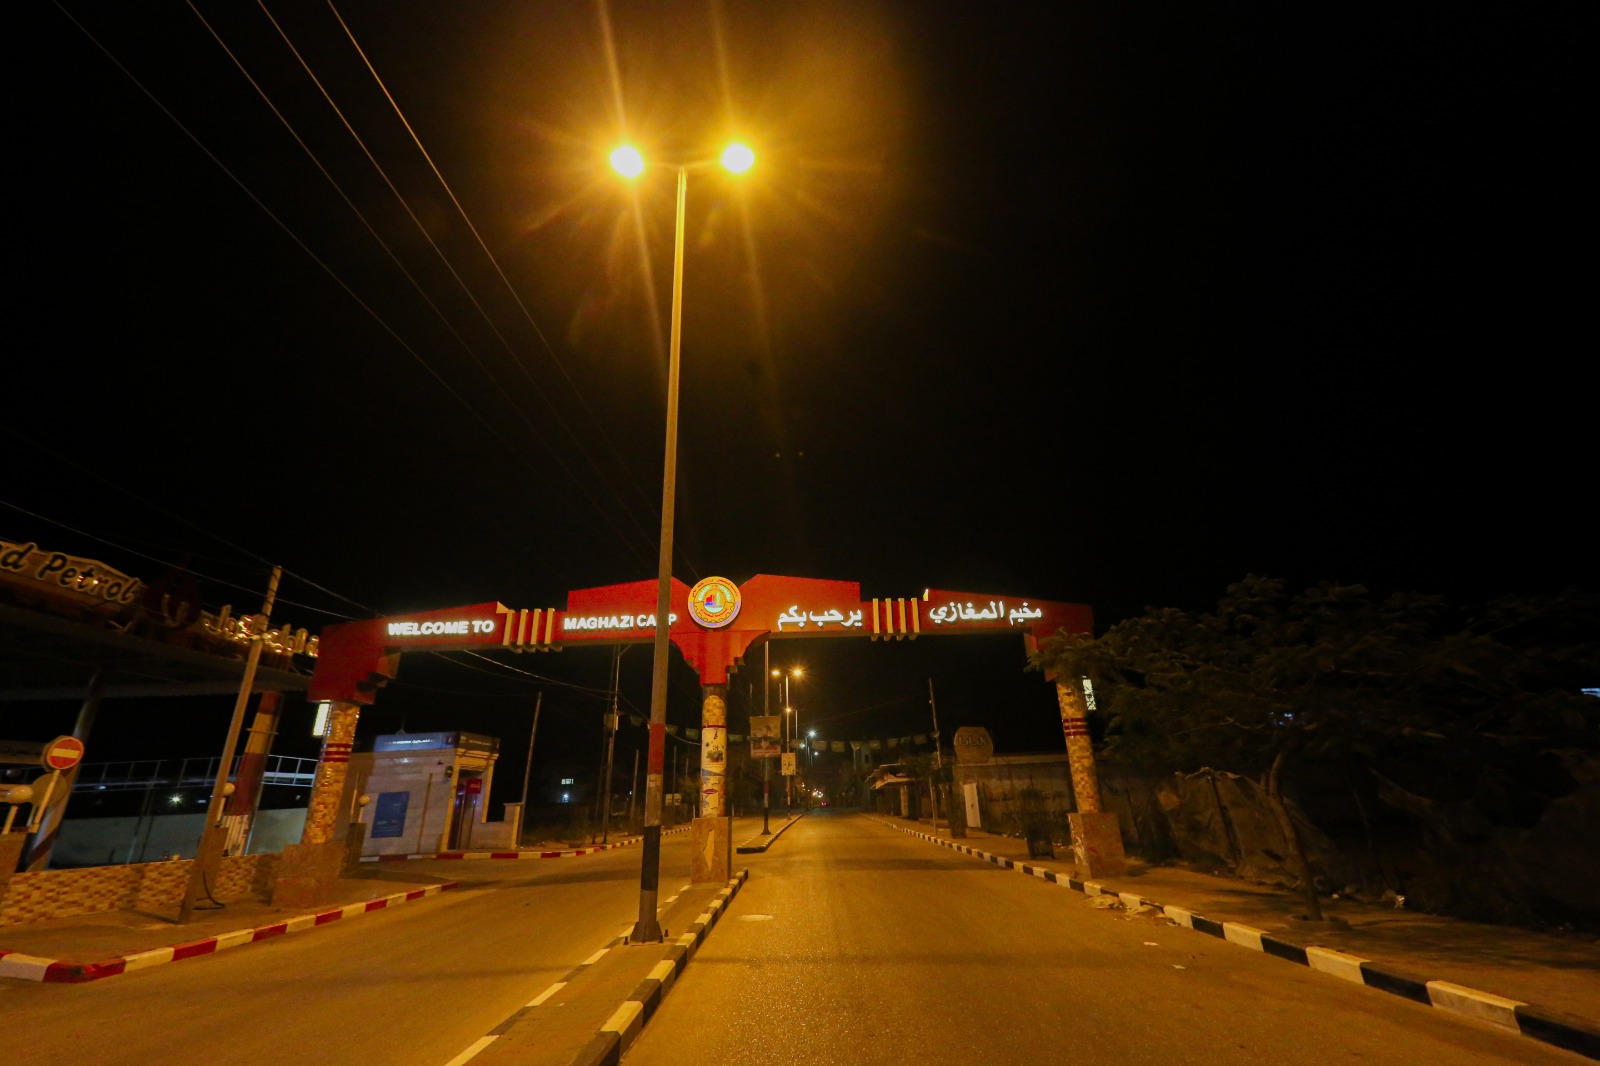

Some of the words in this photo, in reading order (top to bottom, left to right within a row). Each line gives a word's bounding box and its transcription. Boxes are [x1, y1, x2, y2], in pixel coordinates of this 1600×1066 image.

[0, 542, 28, 572] d
[37, 553, 140, 602] Petrol
[777, 604, 807, 632] بكم
[808, 608, 863, 627] يرحب
[929, 600, 1005, 624] المغازي
[1009, 601, 1042, 626] مخيم
[387, 620, 469, 636] WELCOME
[471, 619, 495, 634] TO
[563, 614, 634, 630] MAGHAZI
[636, 613, 678, 628] CAP
